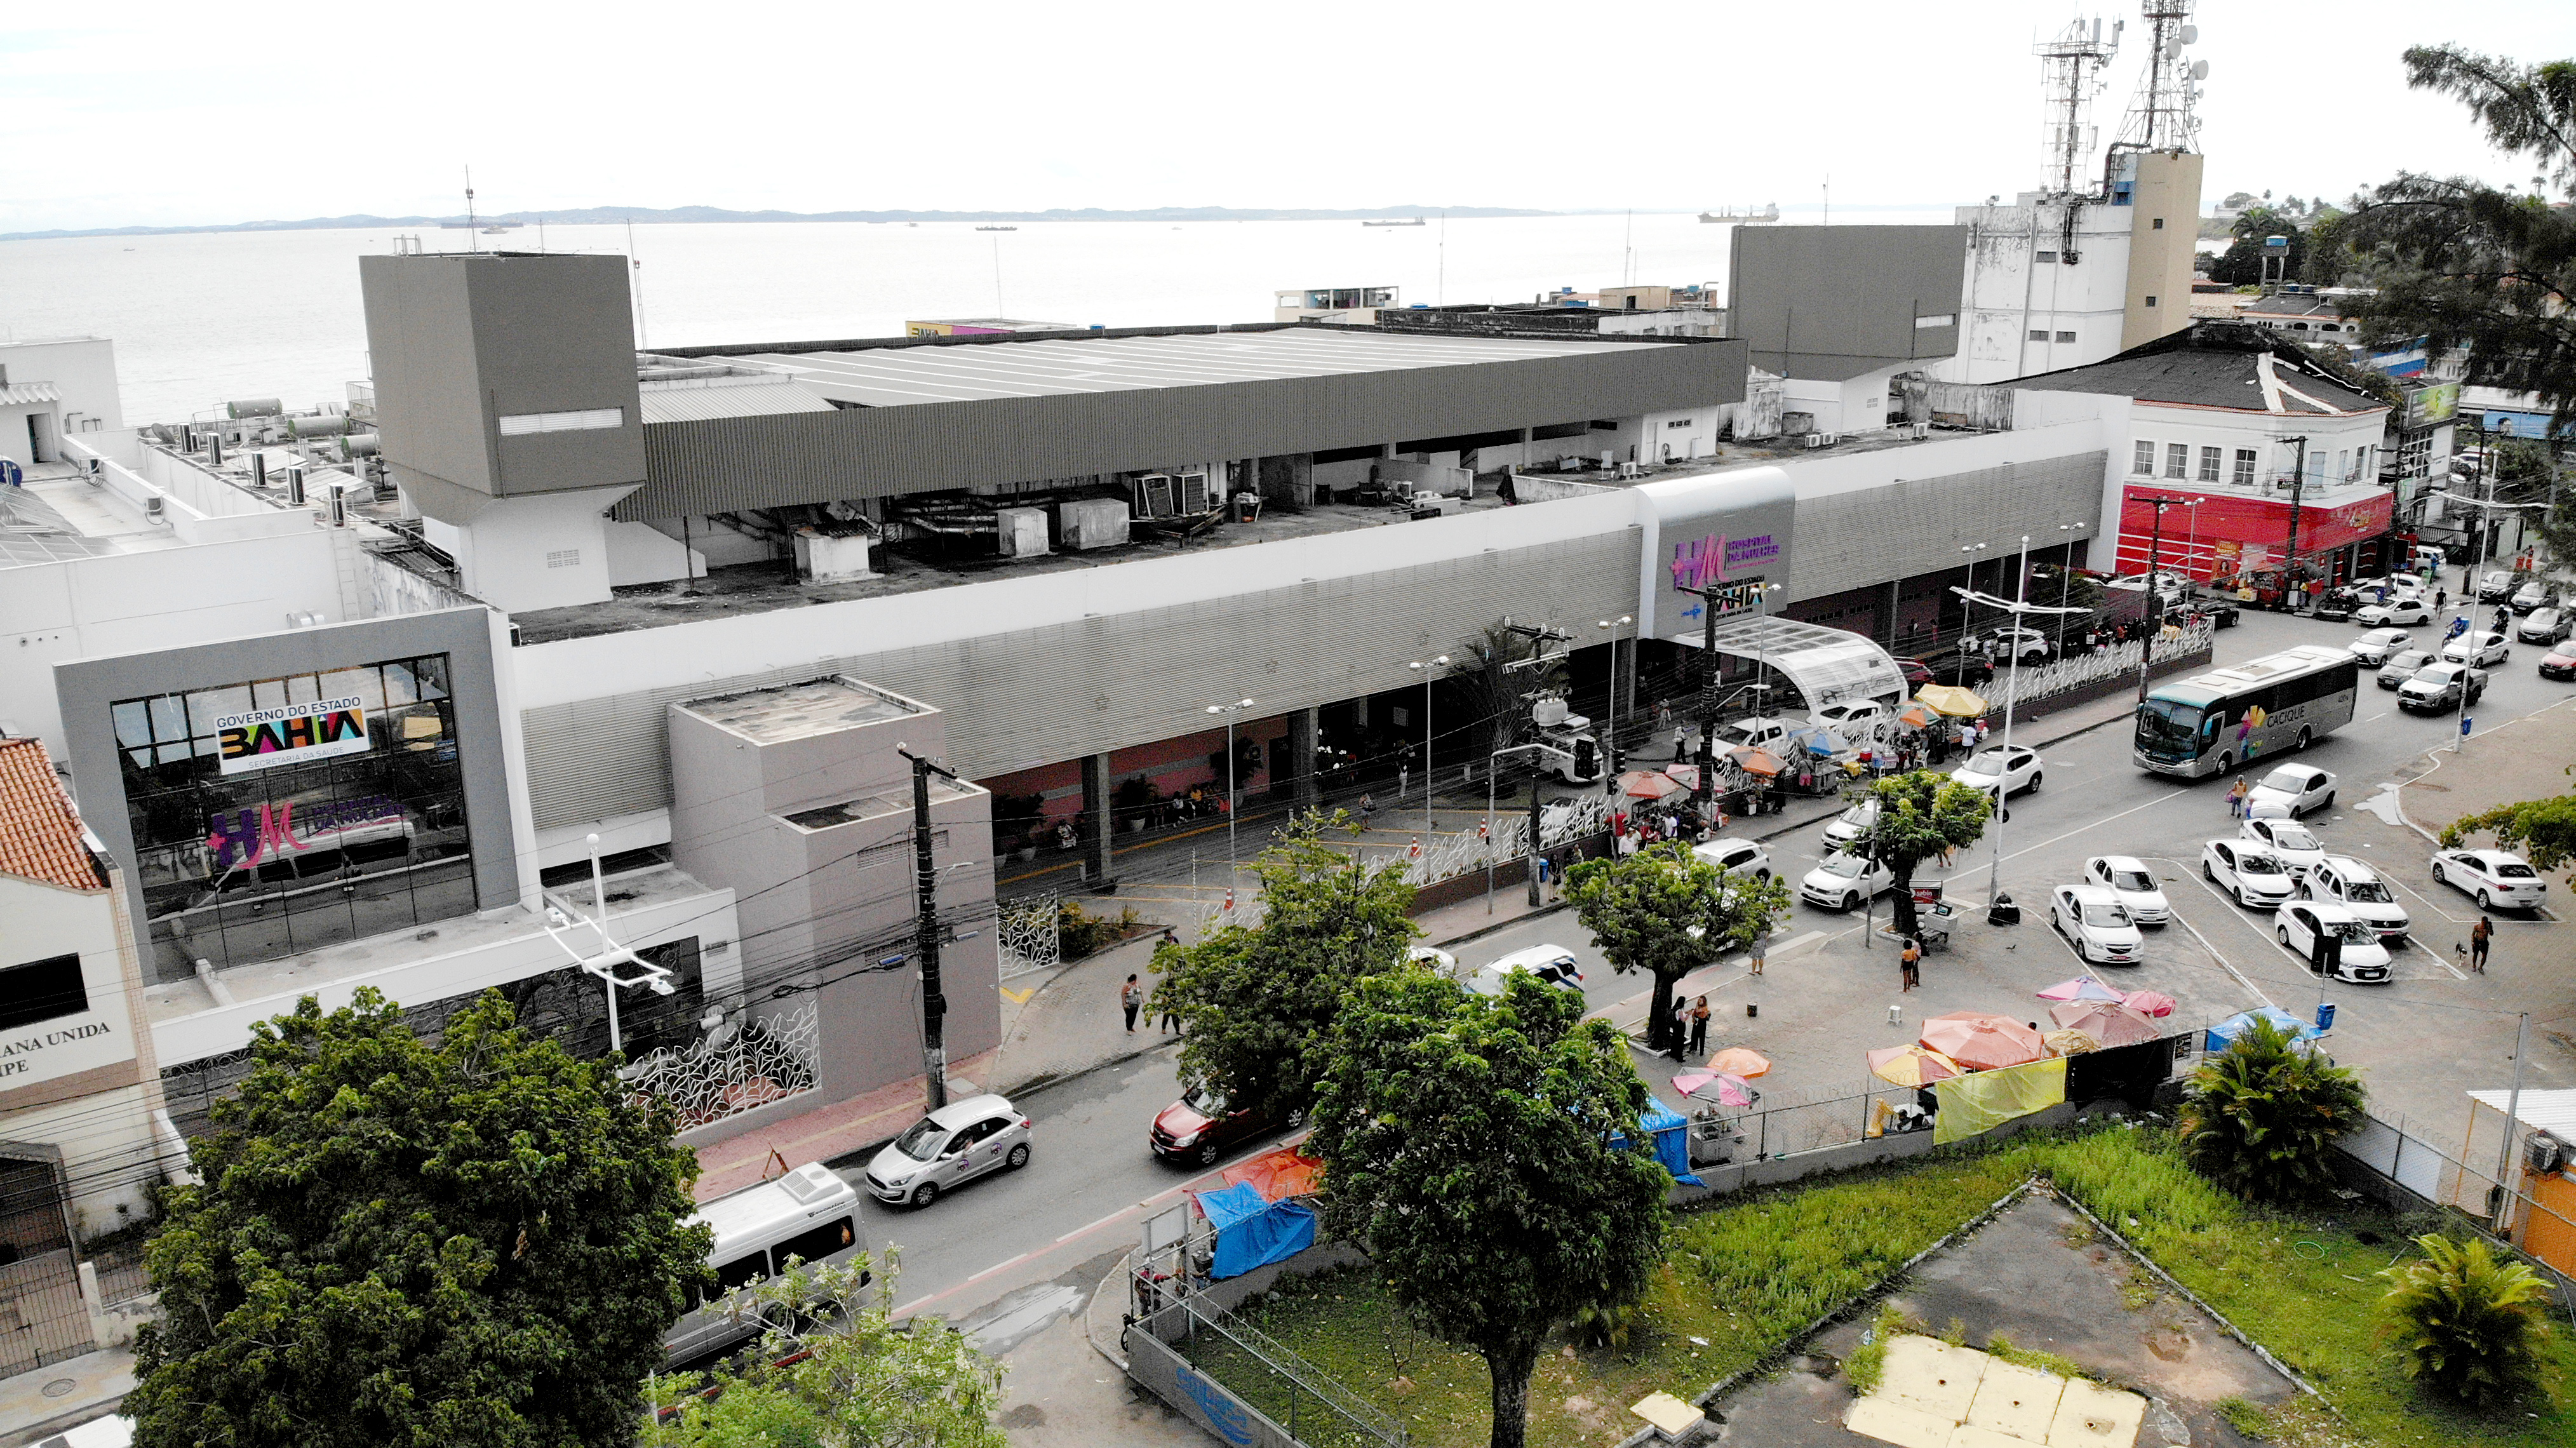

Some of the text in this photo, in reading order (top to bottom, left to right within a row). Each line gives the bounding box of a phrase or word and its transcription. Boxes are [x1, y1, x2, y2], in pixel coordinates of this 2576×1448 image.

[1716, 583, 1764, 612] AHIA
[217, 697, 361, 728] GOVERNO DO ESTADO
[2267, 706, 2305, 728] CACIQUE
[218, 709, 365, 760] BAHIA
[248, 754, 301, 768] SECRETARIA
[316, 746, 344, 758] SAÚDE
[0, 1021, 111, 1058] ANA UNIDA
